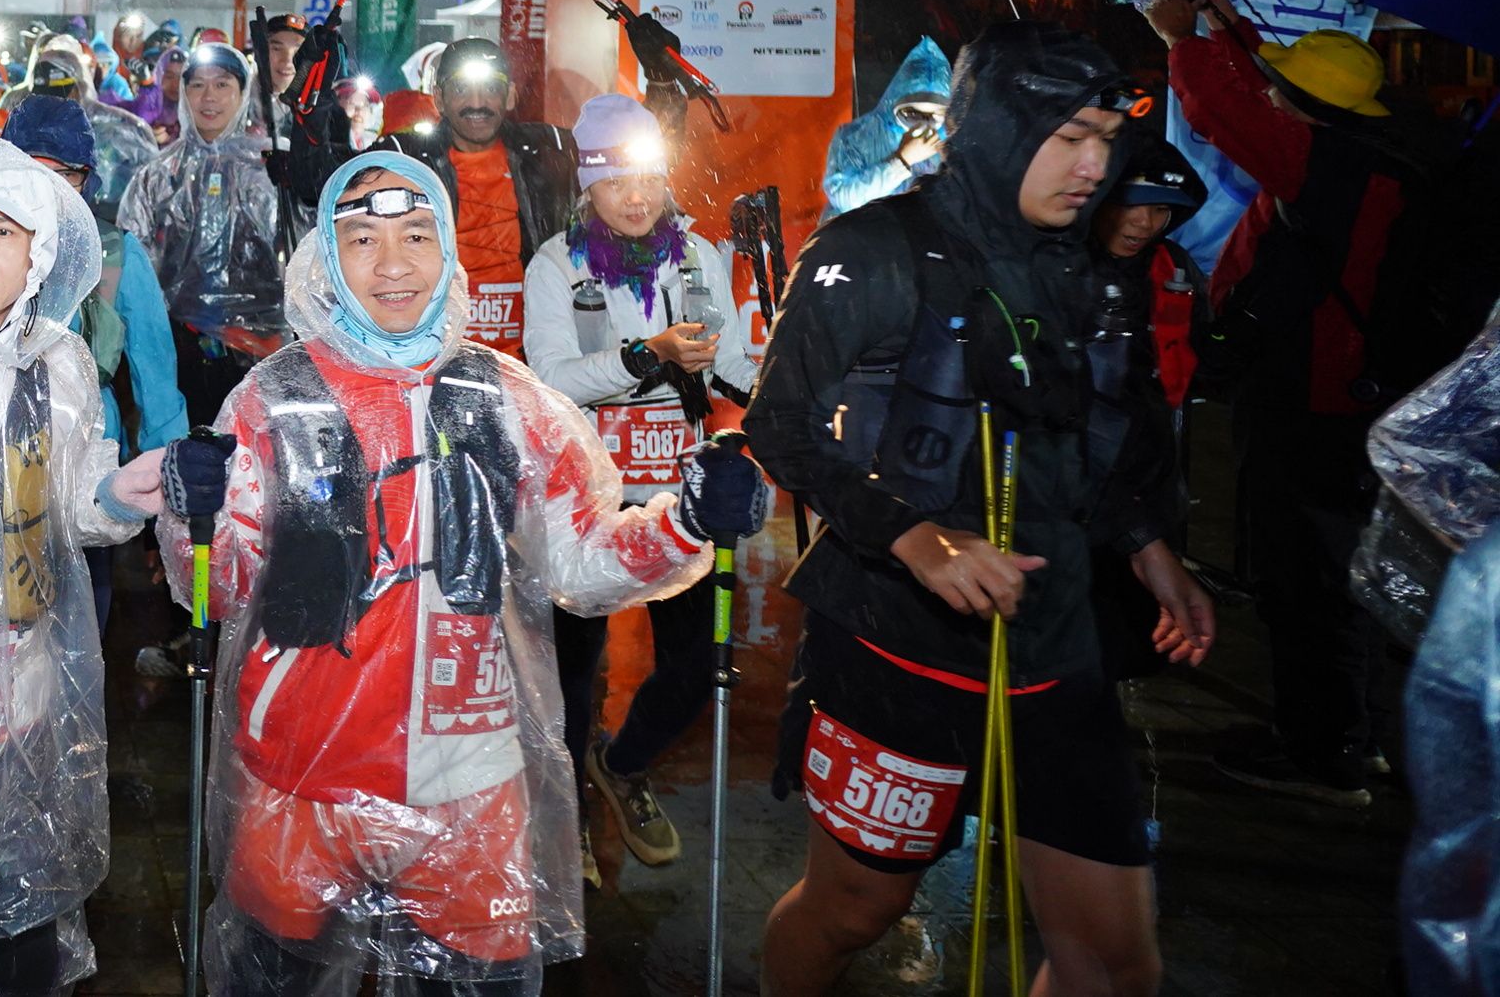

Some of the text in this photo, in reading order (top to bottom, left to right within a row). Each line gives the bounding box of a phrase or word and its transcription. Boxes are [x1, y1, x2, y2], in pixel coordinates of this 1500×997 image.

[753, 47, 821, 56] NITECORE
[467, 299, 513, 323] 5057
[630, 429, 685, 459] 5087
[843, 767, 934, 828] 5168
